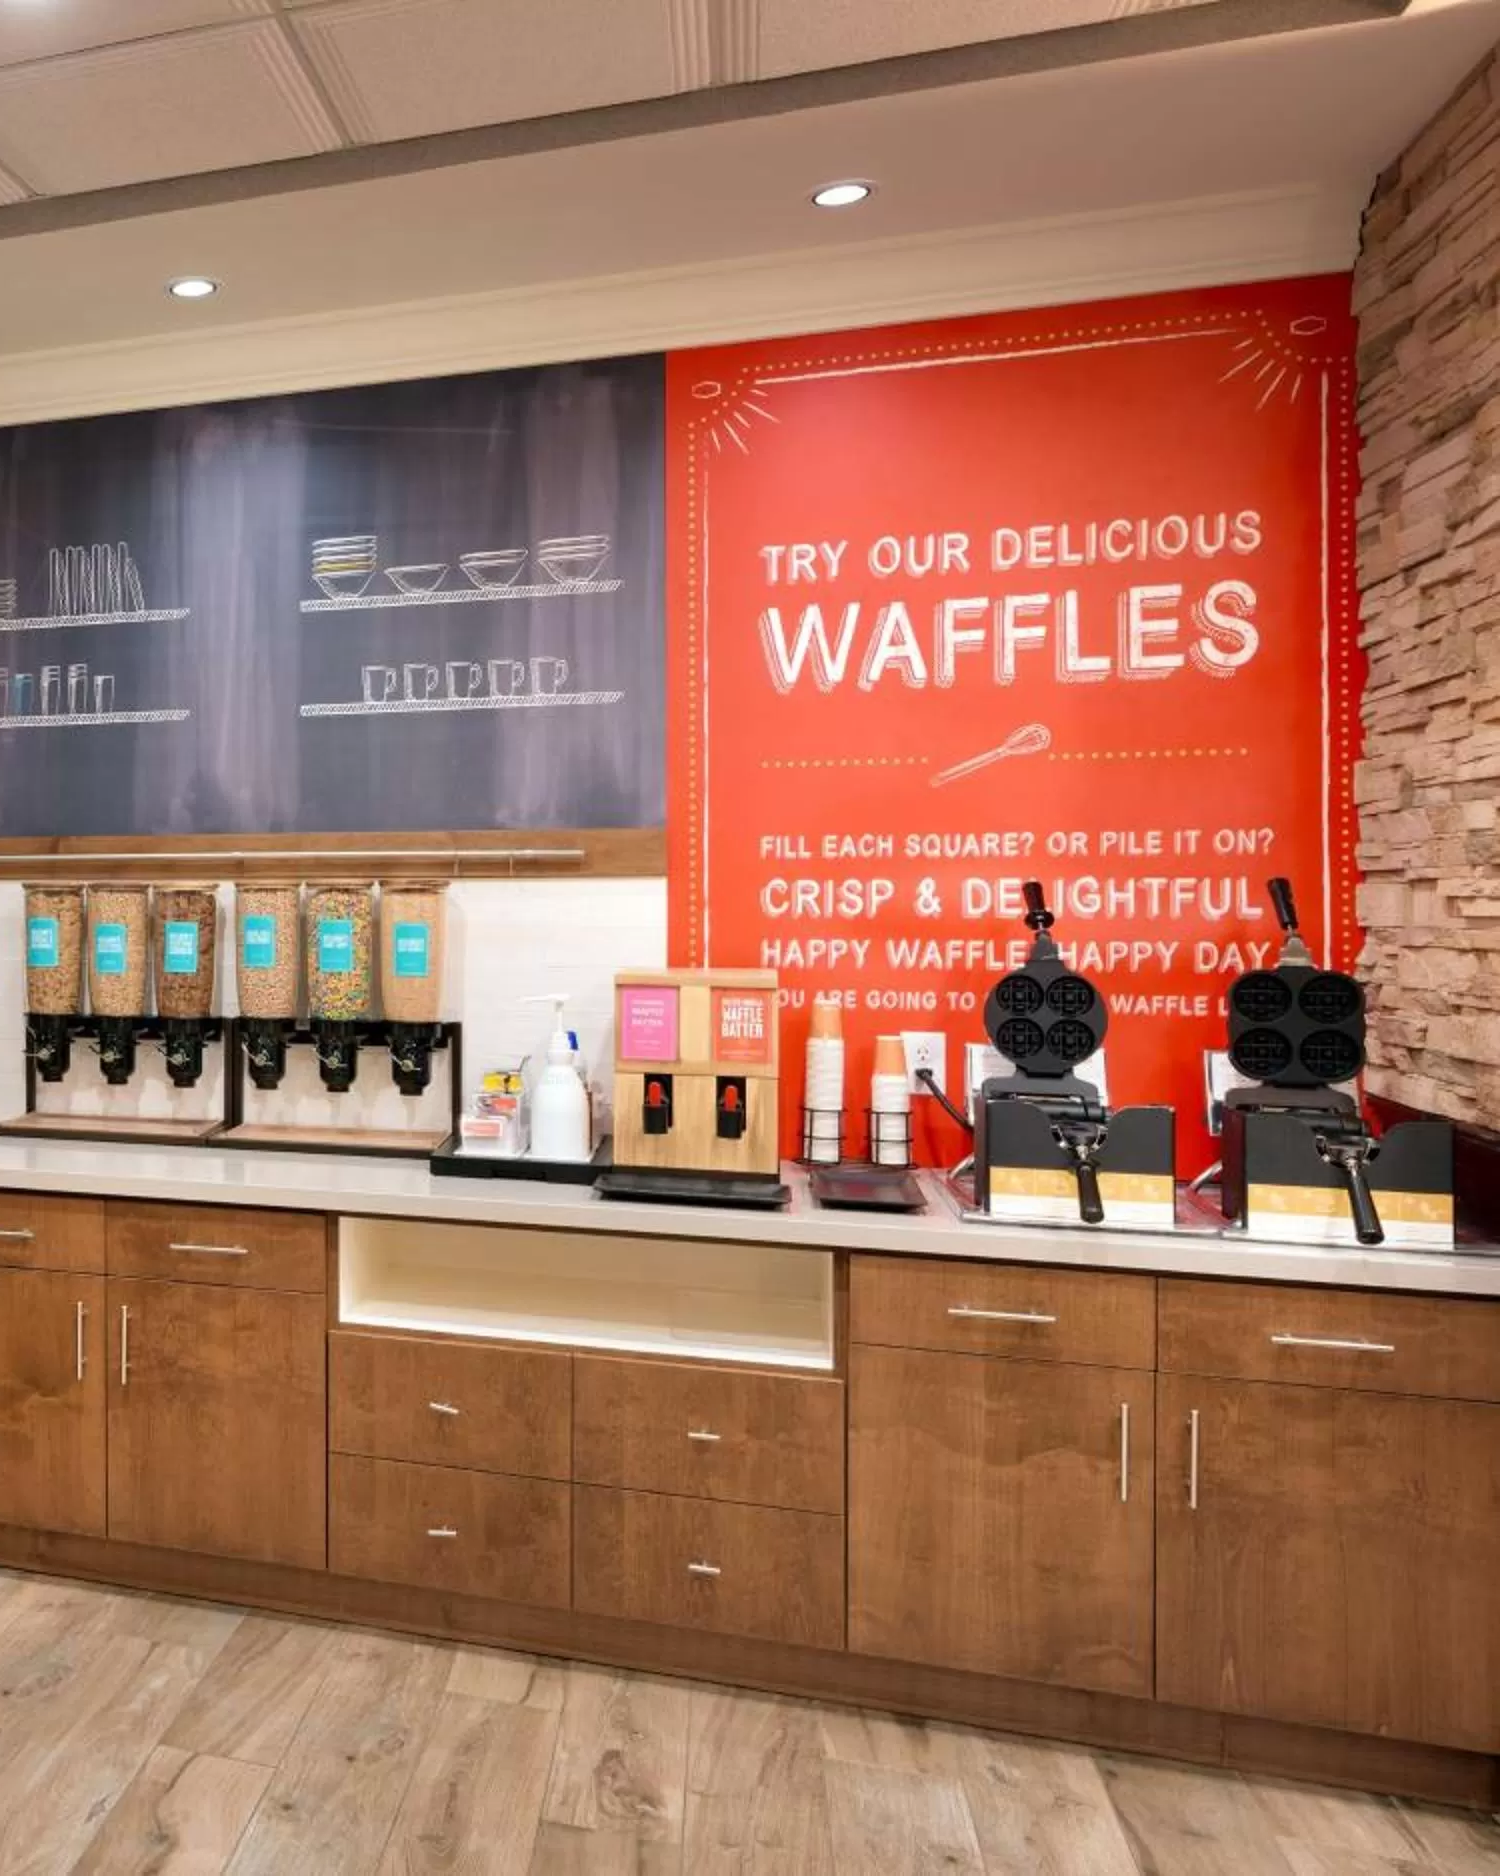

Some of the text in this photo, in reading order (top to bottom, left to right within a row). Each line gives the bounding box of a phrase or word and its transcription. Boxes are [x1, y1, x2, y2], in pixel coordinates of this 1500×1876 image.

[758, 509, 1262, 586] TRY OUR DELICIOUS
[758, 579, 1260, 695] WAFFLES
[760, 827, 1275, 859] FILL EACH SQUARE? OR PILE IT ON?
[760, 875, 1264, 919] CRISP & DEIGHTFUL
[760, 938, 1272, 973] HAPPY WAFFLE HAPPY DAY
[722, 1006, 764, 1023] WAFFLE
[772, 988, 805, 1010] OU
[866, 989, 937, 1011] GOING
[947, 990, 976, 1011] TO
[1109, 993, 1209, 1017] WAFFLE
[721, 1022, 764, 1039] BATTER
